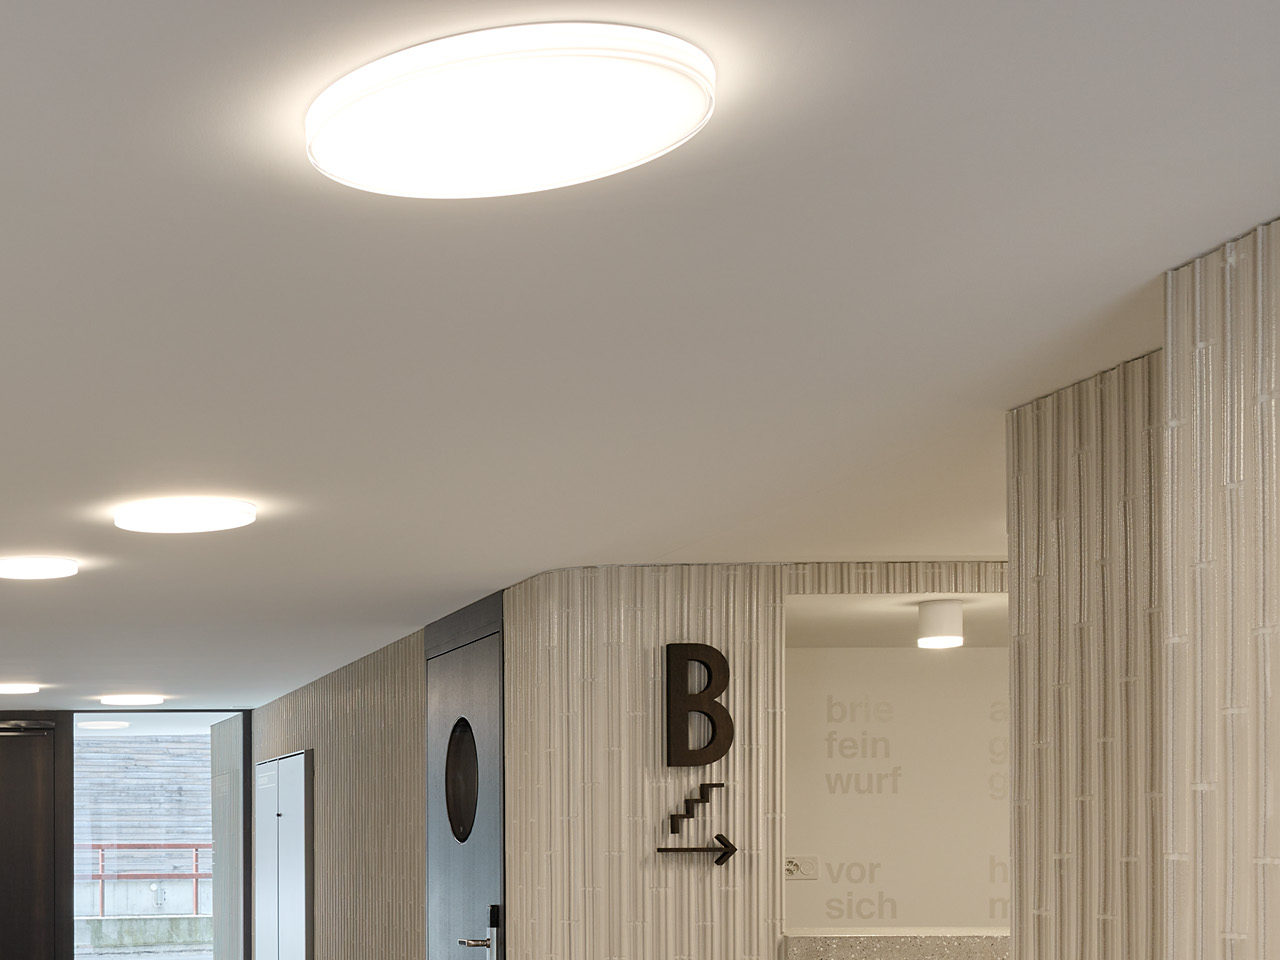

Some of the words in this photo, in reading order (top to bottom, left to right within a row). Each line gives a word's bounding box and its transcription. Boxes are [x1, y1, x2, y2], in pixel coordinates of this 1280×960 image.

[666, 643, 734, 767] B
[826, 695, 894, 723] brie
[824, 731, 890, 759] fein
[825, 766, 903, 795] wurf
[825, 861, 881, 884] vor
[825, 891, 897, 920] sich
